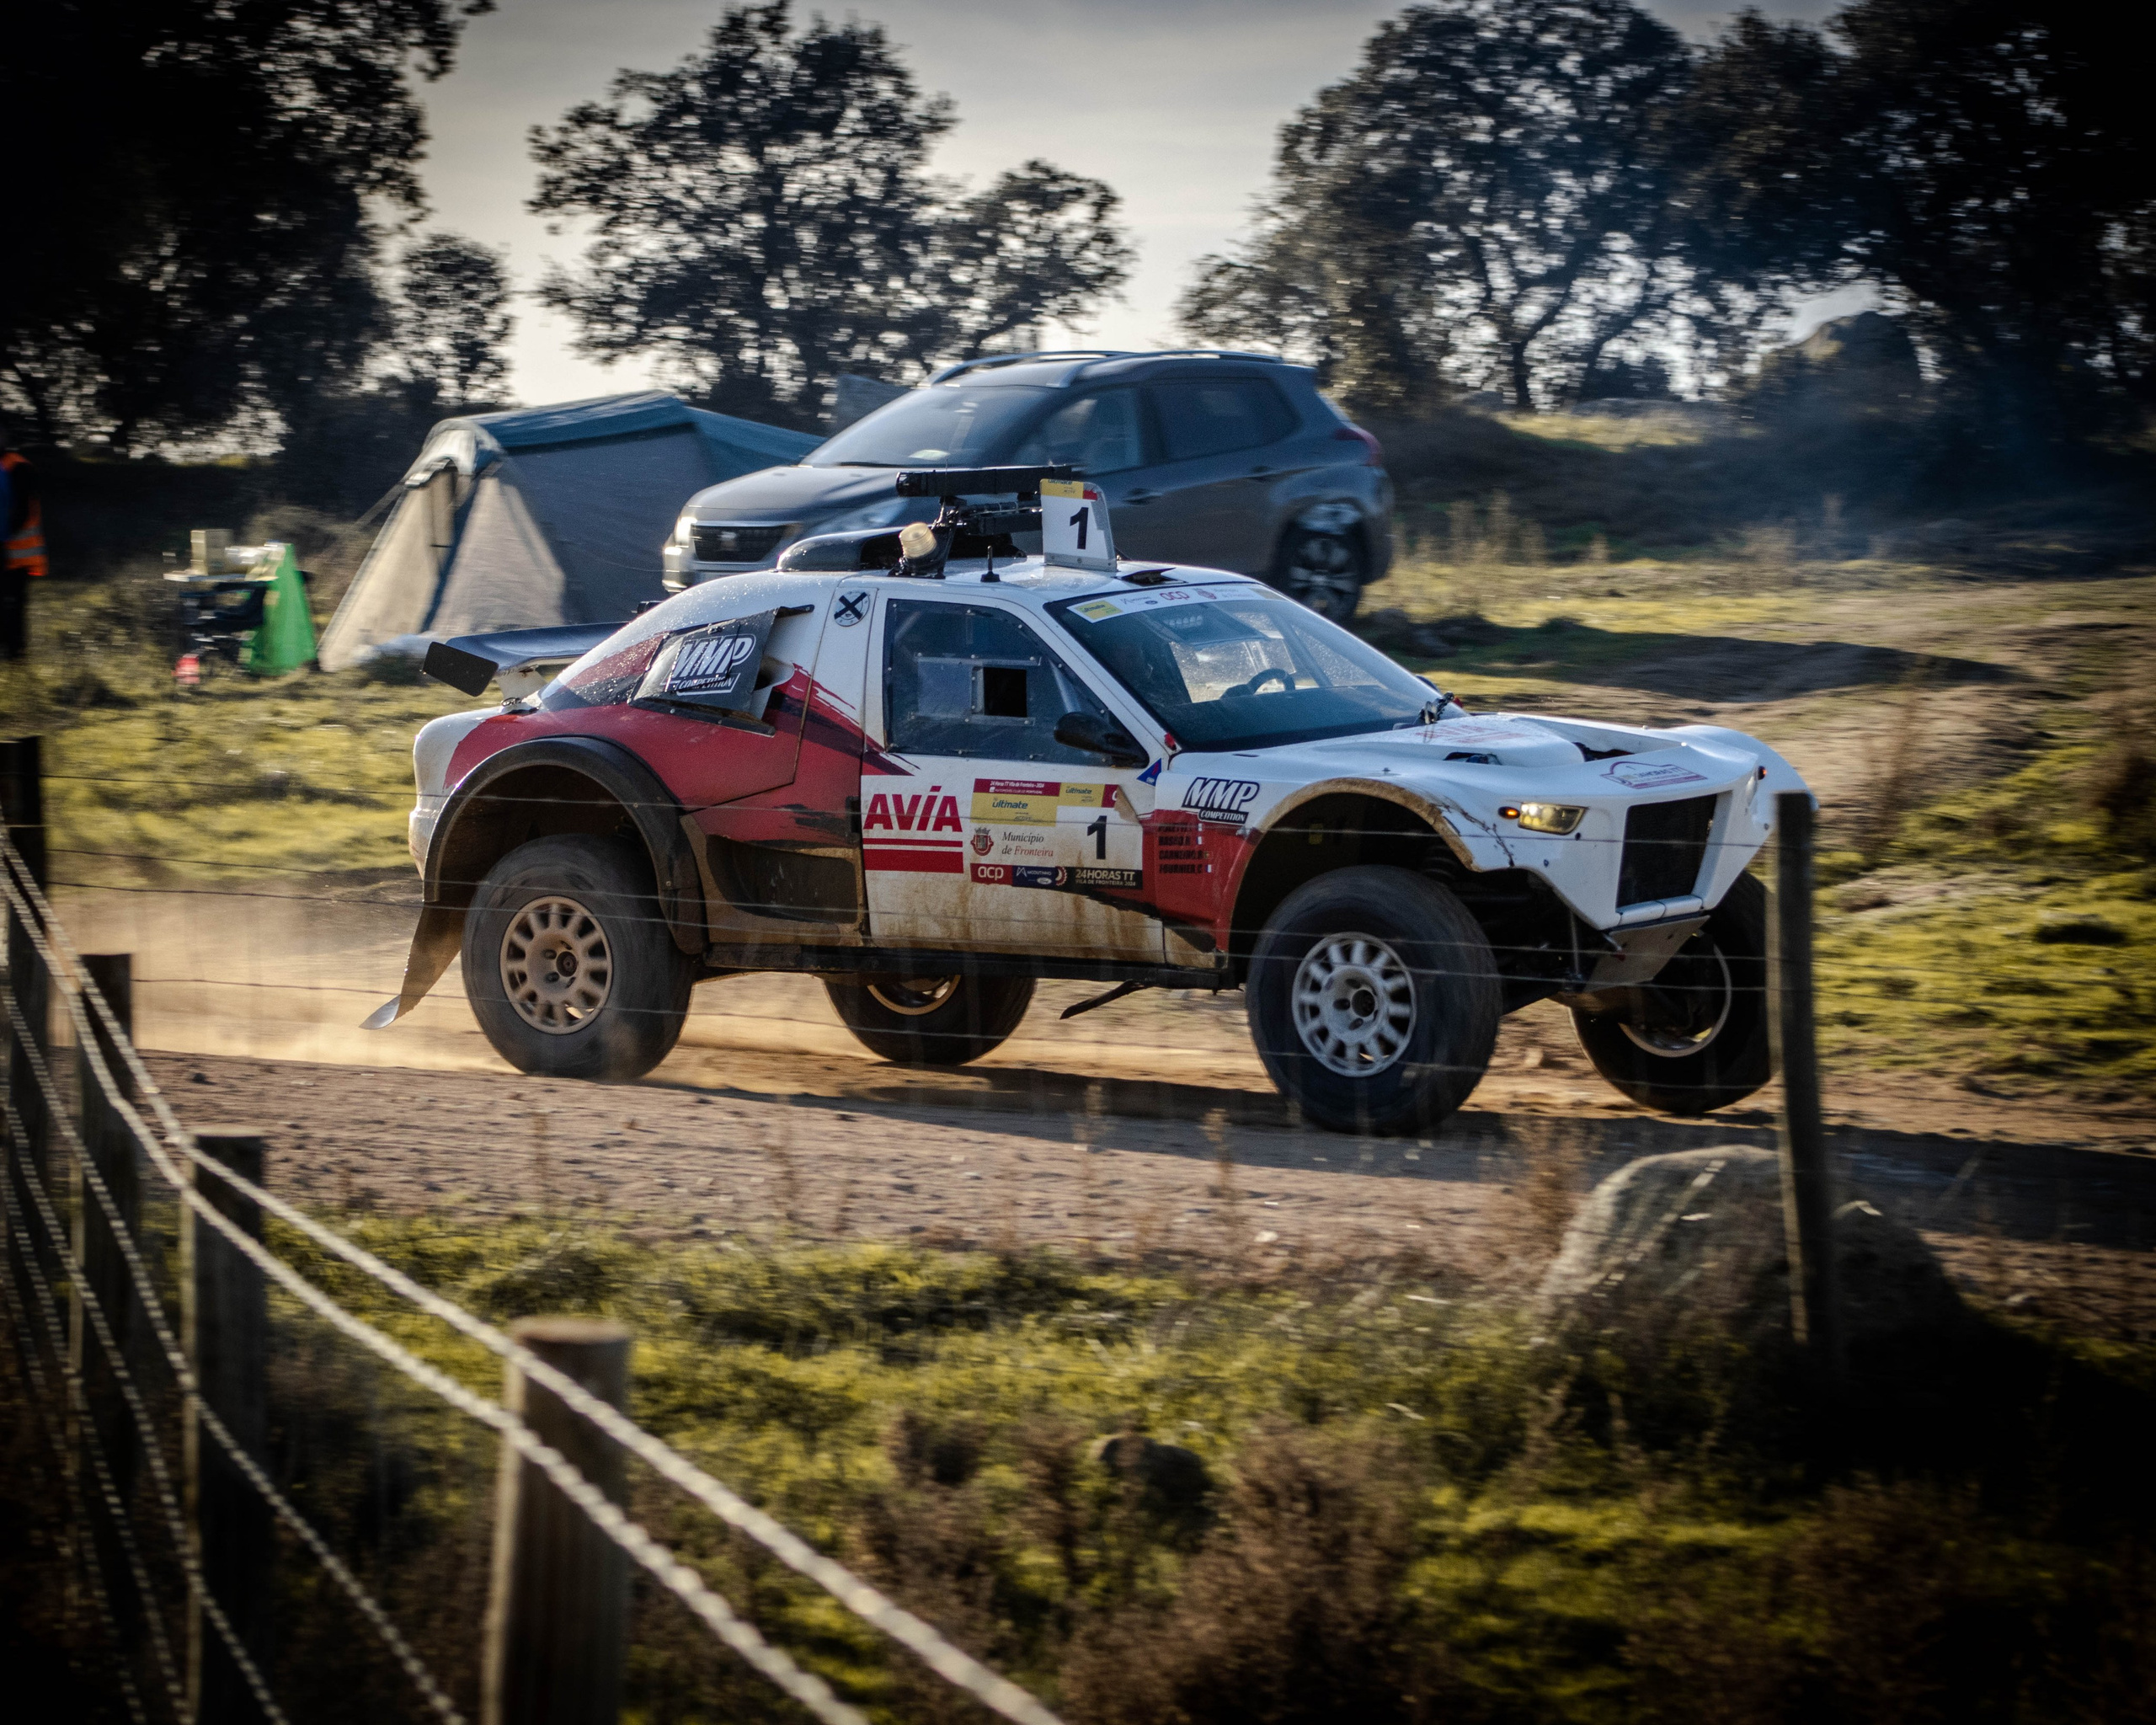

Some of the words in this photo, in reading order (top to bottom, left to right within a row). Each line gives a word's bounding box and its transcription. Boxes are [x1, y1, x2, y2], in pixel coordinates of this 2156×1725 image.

[1069, 506, 1089, 550] 1
[671, 634, 755, 677] MMP
[1182, 777, 1261, 812] MMP
[863, 786, 963, 833] AVÍA
[992, 799, 1028, 809] ultimate
[1199, 809, 1246, 822] COMPETITION
[1002, 831, 1044, 845] Município
[1086, 815, 1107, 860] 1
[1002, 845, 1012, 856] de
[1014, 845, 1054, 857] Fronteira
[978, 866, 1004, 881] acp
[1123, 871, 1135, 881] TT
